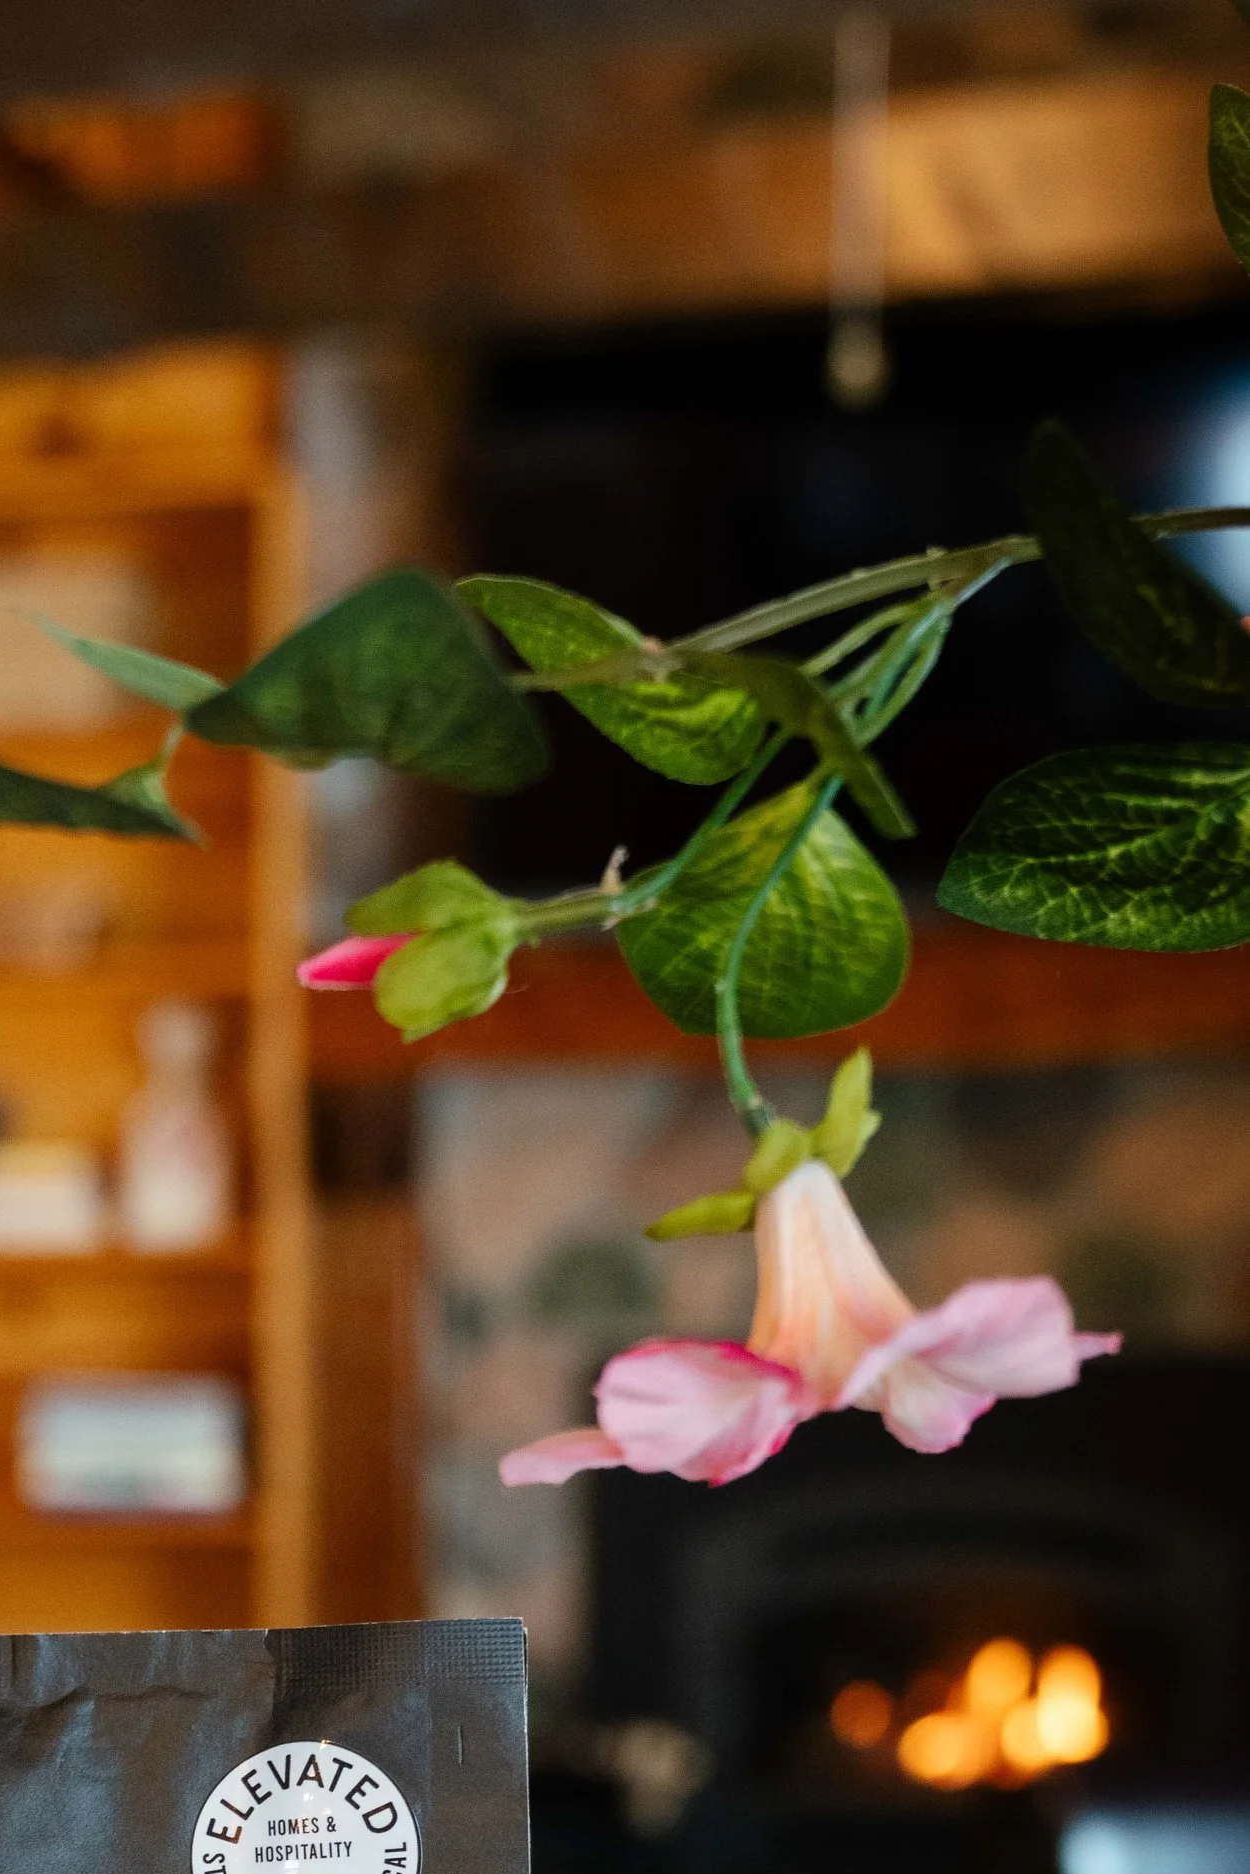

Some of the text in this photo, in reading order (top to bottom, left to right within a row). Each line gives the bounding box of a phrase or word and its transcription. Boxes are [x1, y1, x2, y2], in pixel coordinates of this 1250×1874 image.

[206, 1754, 398, 1844] ELEVATED
[268, 1816, 337, 1836] HOMES &
[255, 1841, 352, 1862] HOSPITALITY
